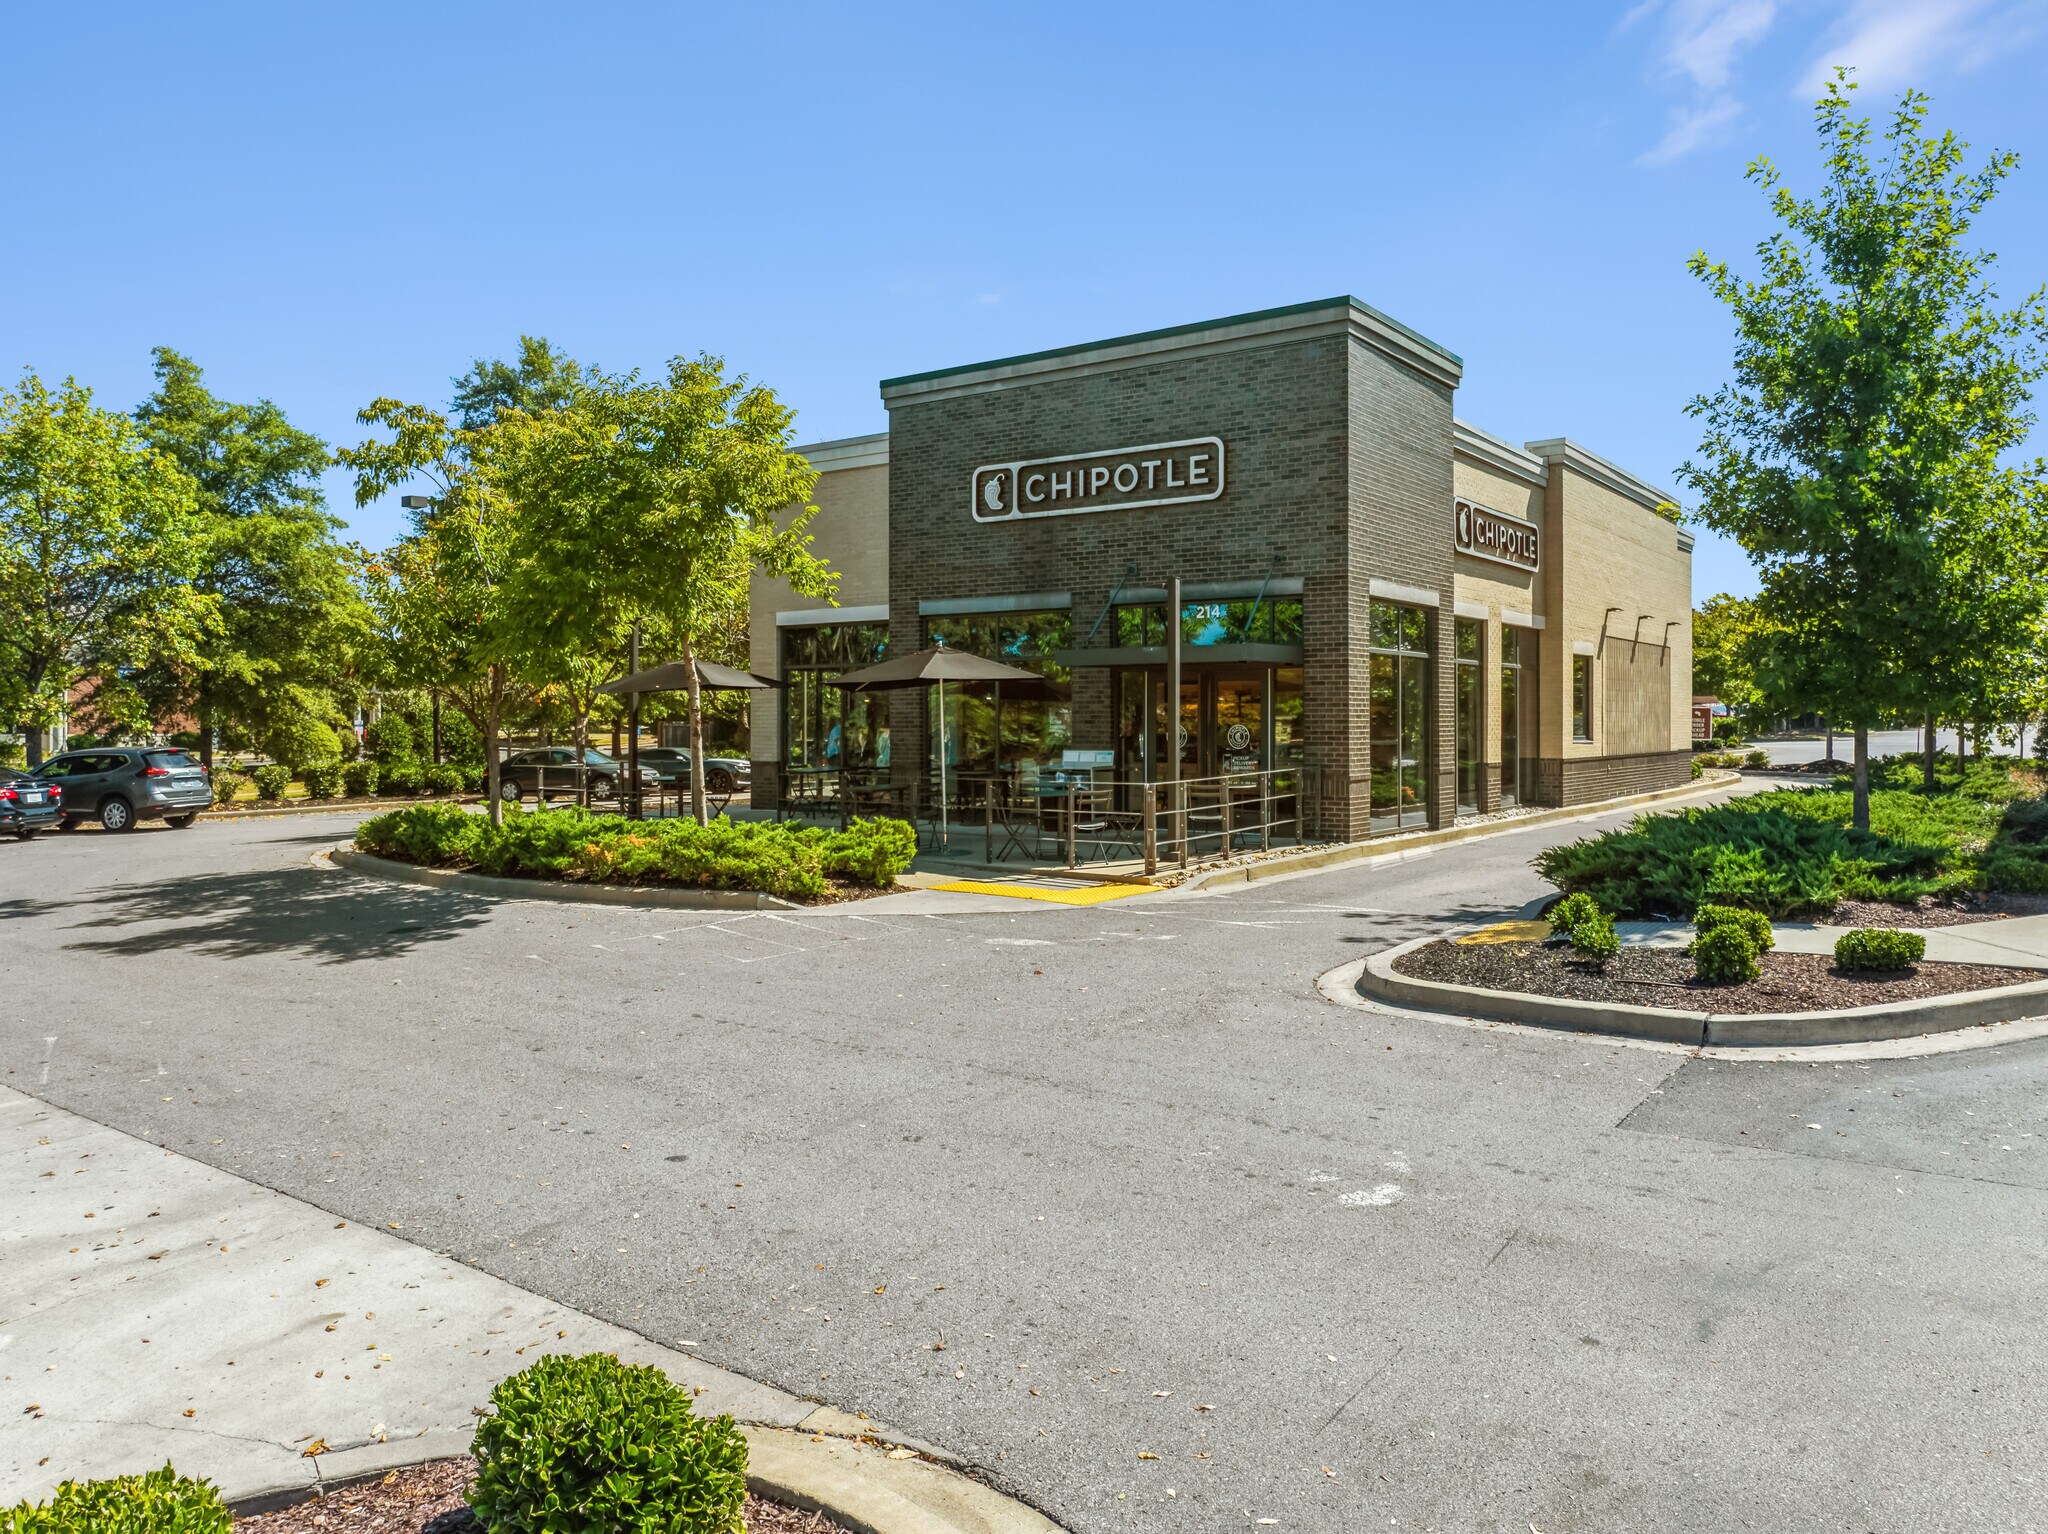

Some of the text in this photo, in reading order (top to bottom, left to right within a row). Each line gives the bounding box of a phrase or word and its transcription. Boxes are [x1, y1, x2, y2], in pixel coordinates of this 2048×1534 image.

[1025, 454, 1209, 502] CHIPOTLE
[1476, 517, 1536, 559] CHIPOTLE
[1196, 604, 1221, 619] 214
